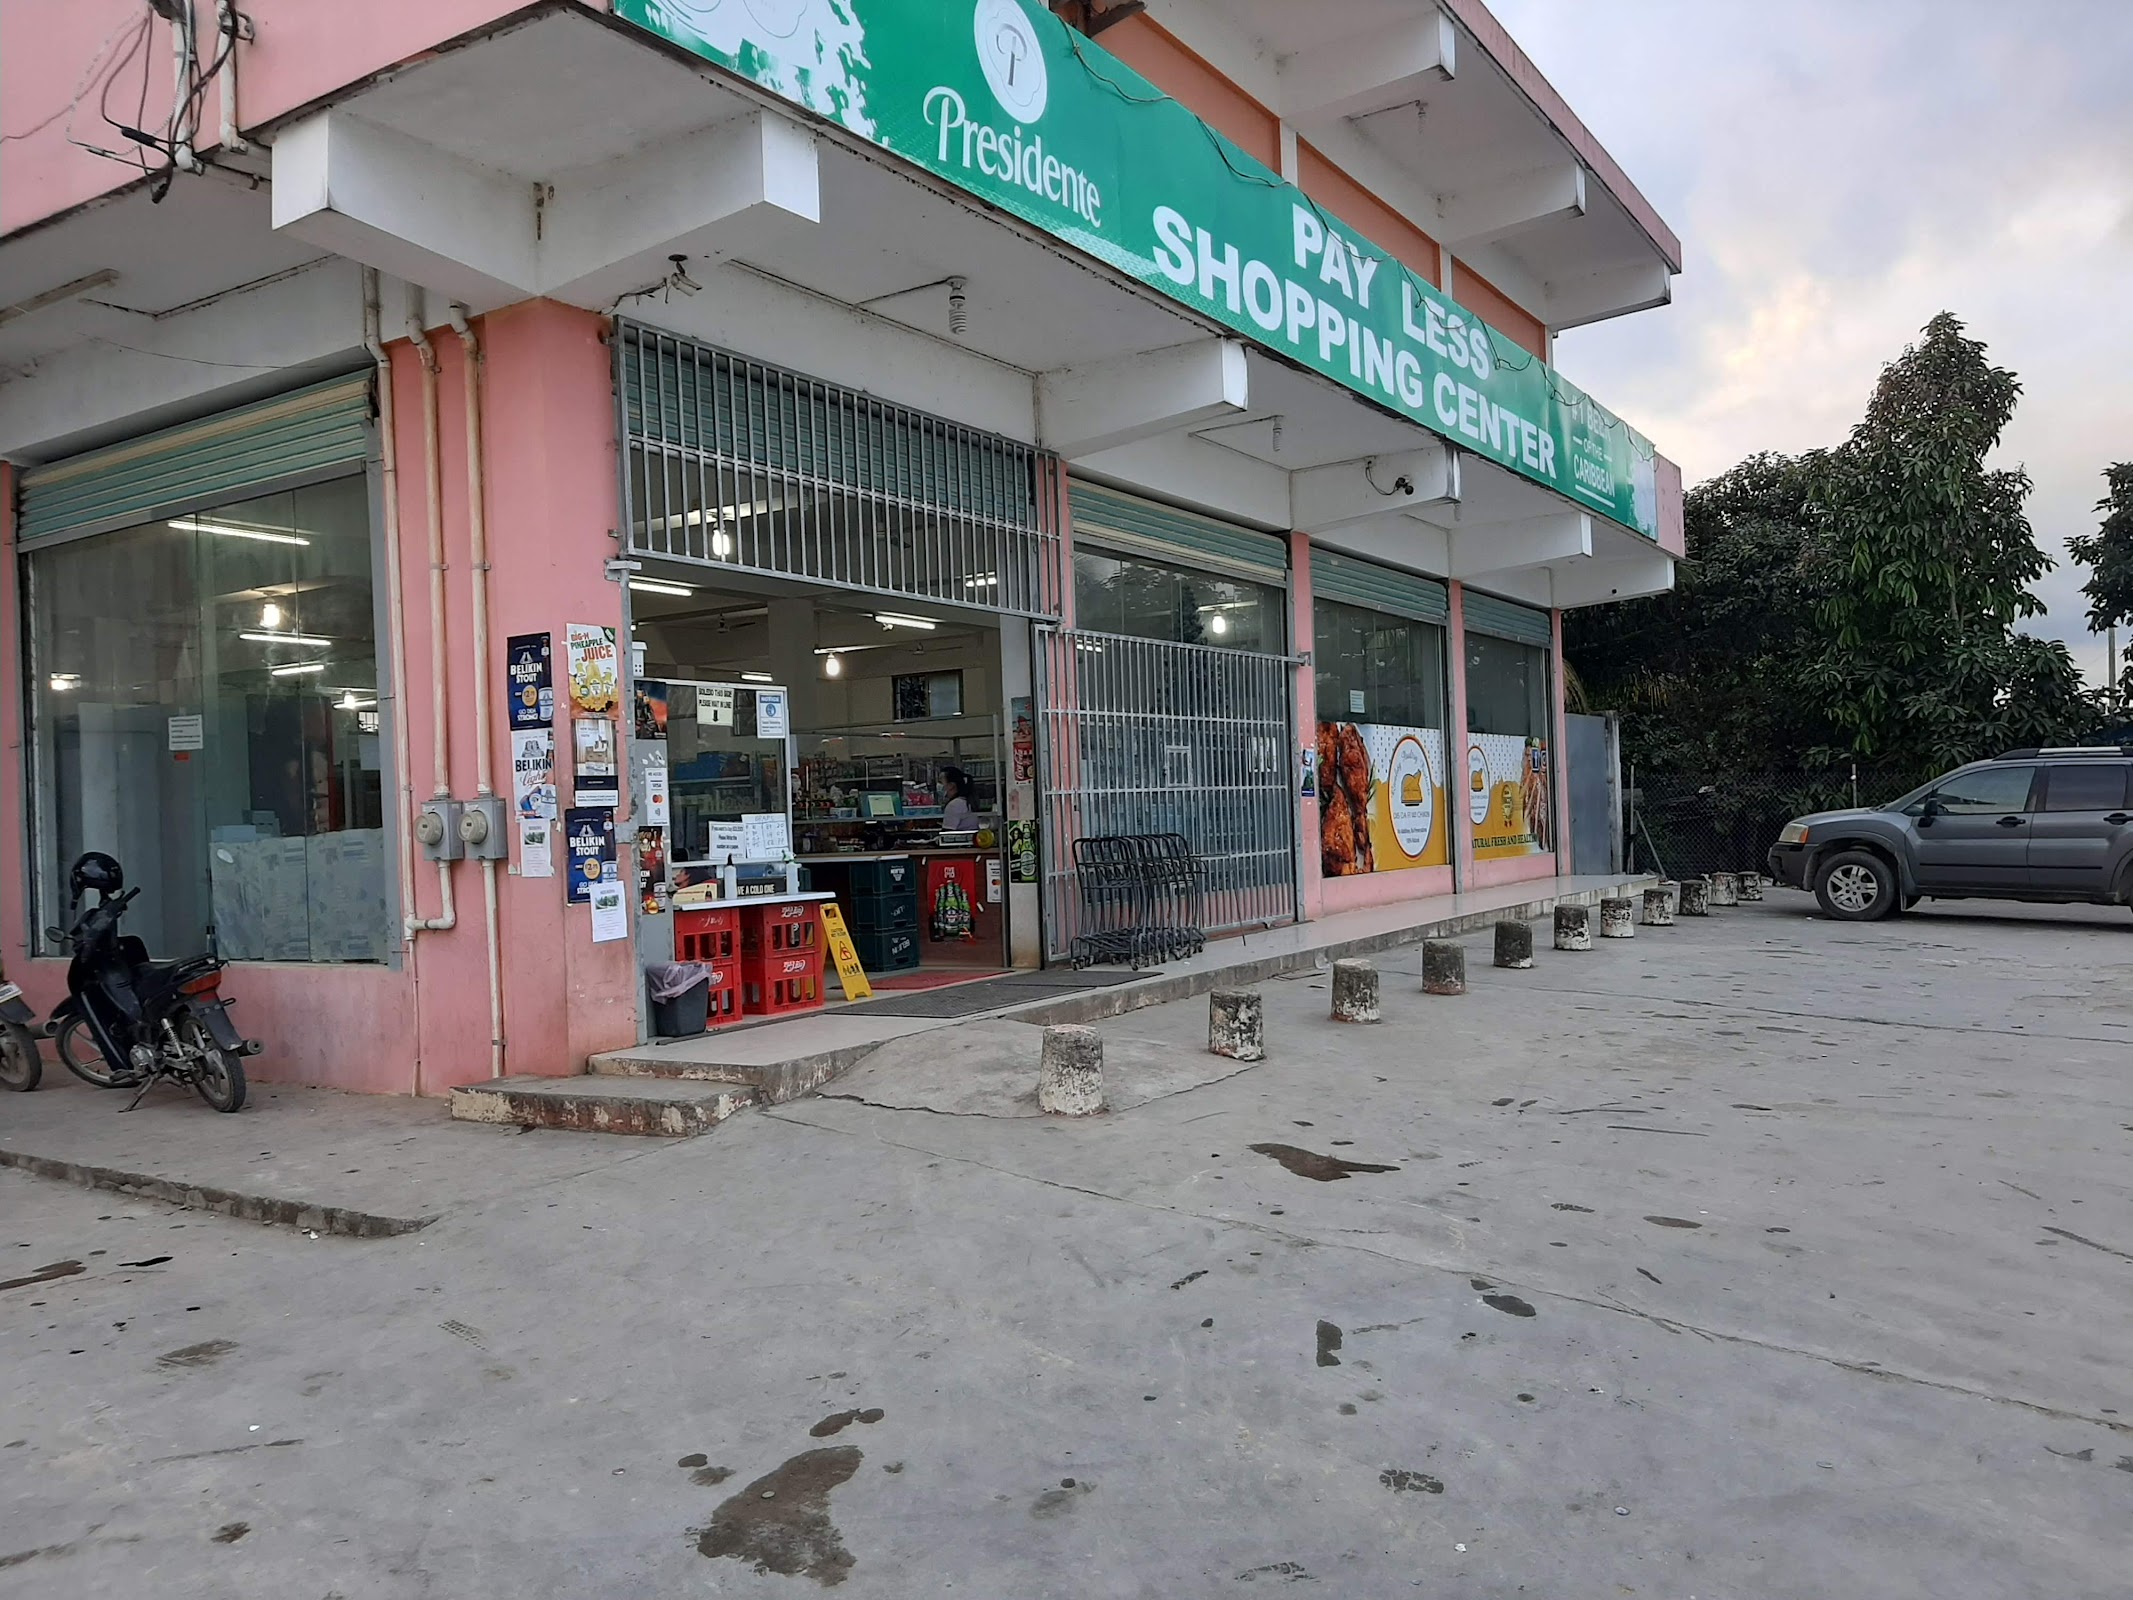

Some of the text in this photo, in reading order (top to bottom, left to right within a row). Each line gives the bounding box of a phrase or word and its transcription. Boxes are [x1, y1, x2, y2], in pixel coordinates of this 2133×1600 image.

[923, 86, 1101, 228] Presidente
[1292, 202, 1377, 309] PAY
[1402, 280, 1490, 380] LESS
[1152, 205, 1557, 479] SHOPPING CENTER
[1571, 395, 1611, 442] #1 BEER
[1583, 437, 1603, 461] OF THE
[1573, 453, 1616, 498] CARIBBEAN
[570, 638, 603, 650] PINEAPPLE
[581, 644, 613, 662] JUICE
[510, 662, 543, 676] BELIKIN
[516, 673, 537, 684] STOUT
[515, 758, 552, 772] BELIKIN
[569, 836, 605, 848] BELIKIN
[1472, 837, 1491, 848] TURAL
[1491, 836, 1506, 847] FRESH
[1507, 835, 1517, 845] AND
[576, 847, 600, 856] STOUT
[745, 885, 750, 895] A
[750, 884, 763, 895] COLD
[764, 884, 775, 894] ONE
